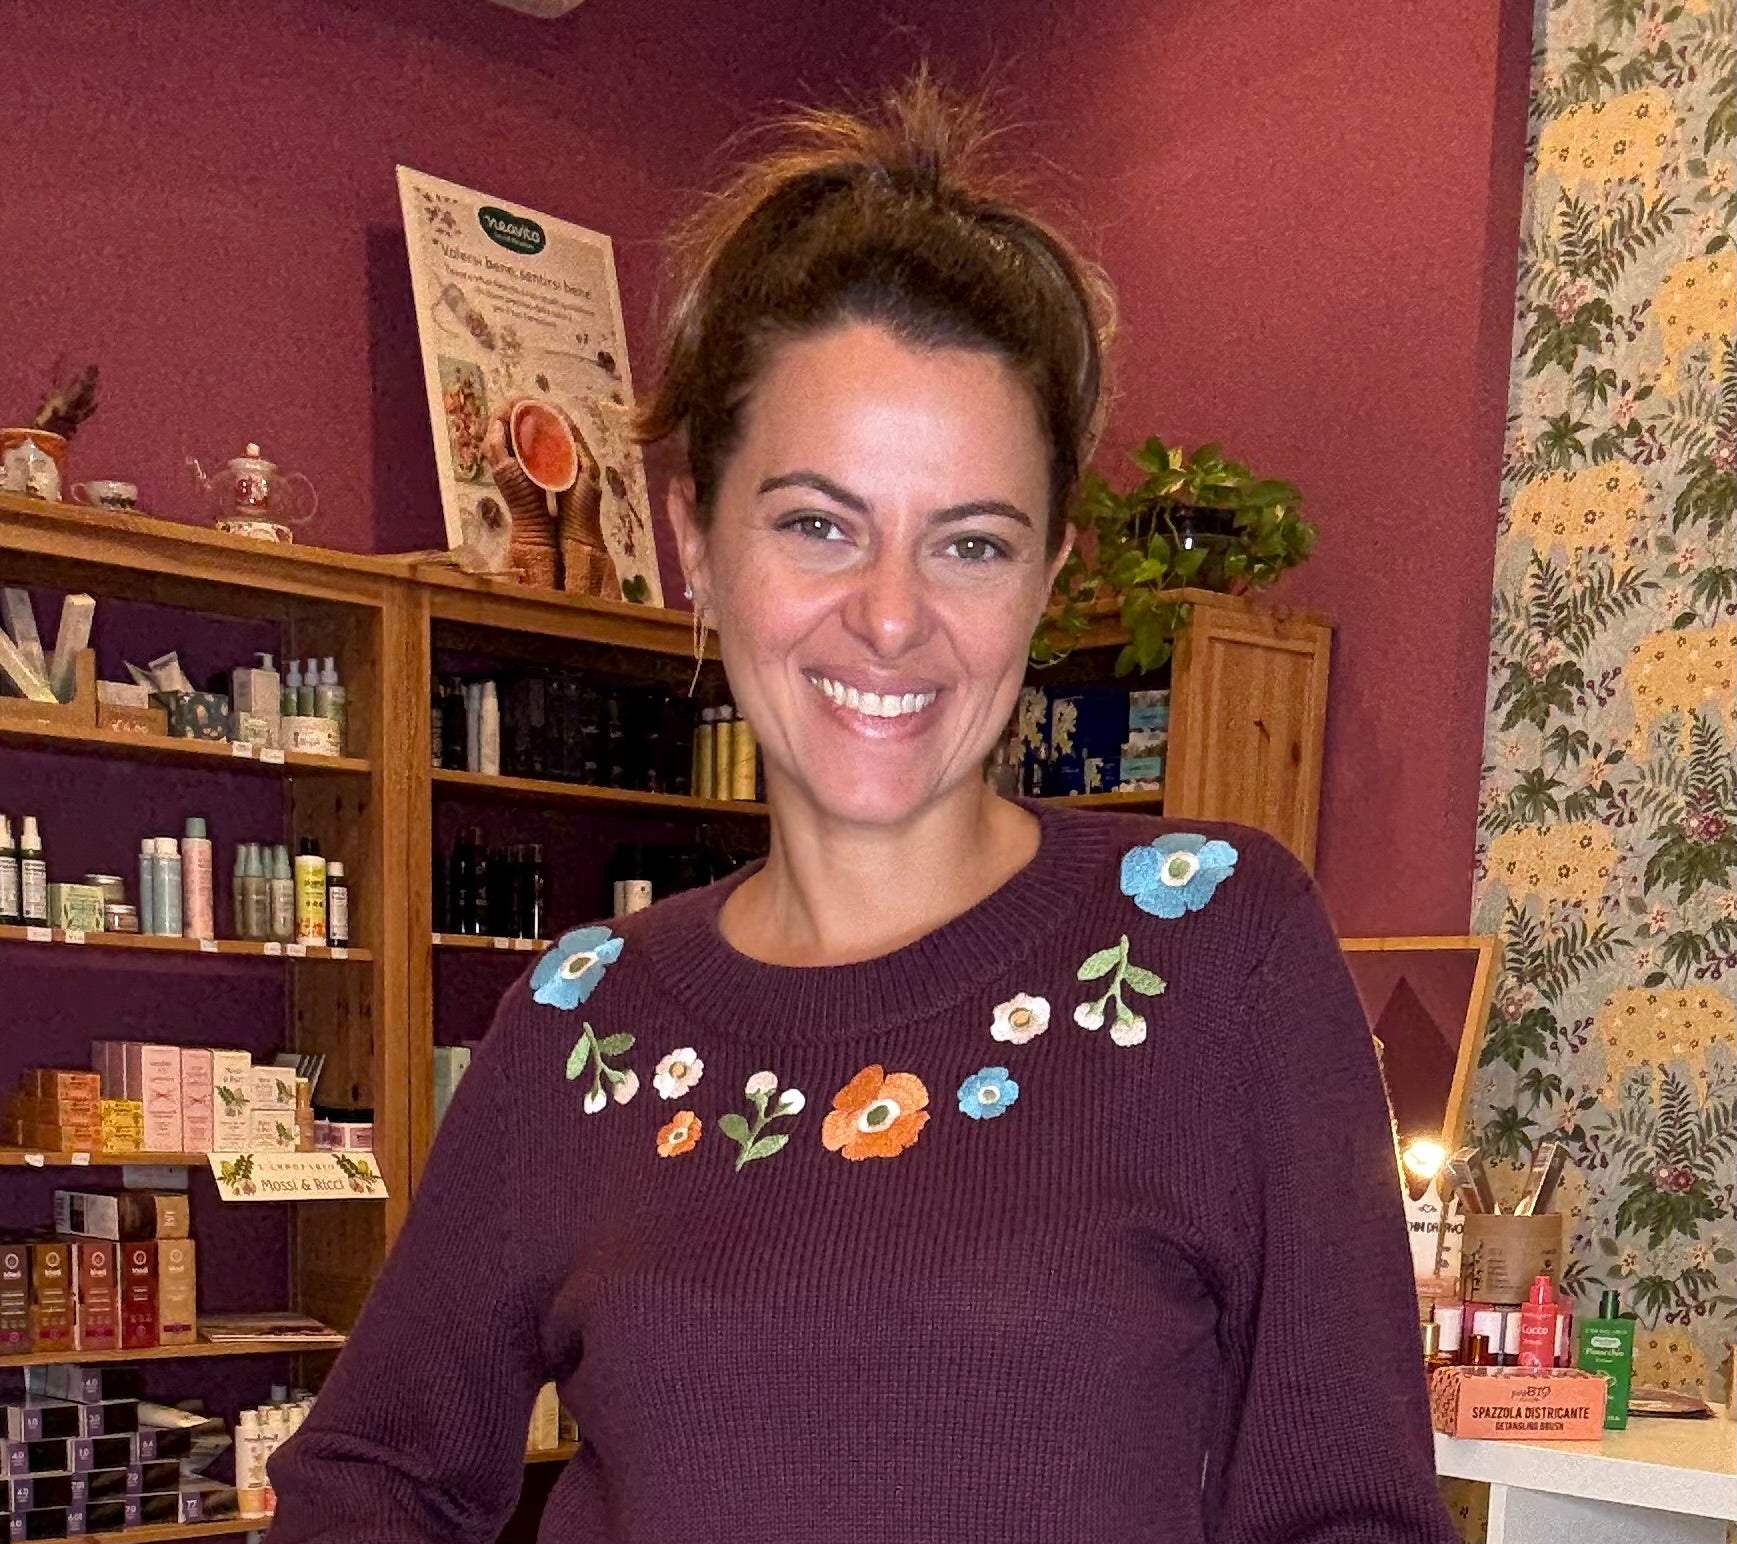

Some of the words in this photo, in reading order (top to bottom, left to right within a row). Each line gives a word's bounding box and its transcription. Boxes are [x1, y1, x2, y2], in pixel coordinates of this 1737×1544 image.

[484, 215, 541, 243] neavita
[563, 280, 591, 300] bene
[301, 1178, 312, 1191] &
[1472, 1406, 1522, 1420] SPAZZOLA
[1525, 1406, 1590, 1420] DISTRICANTE
